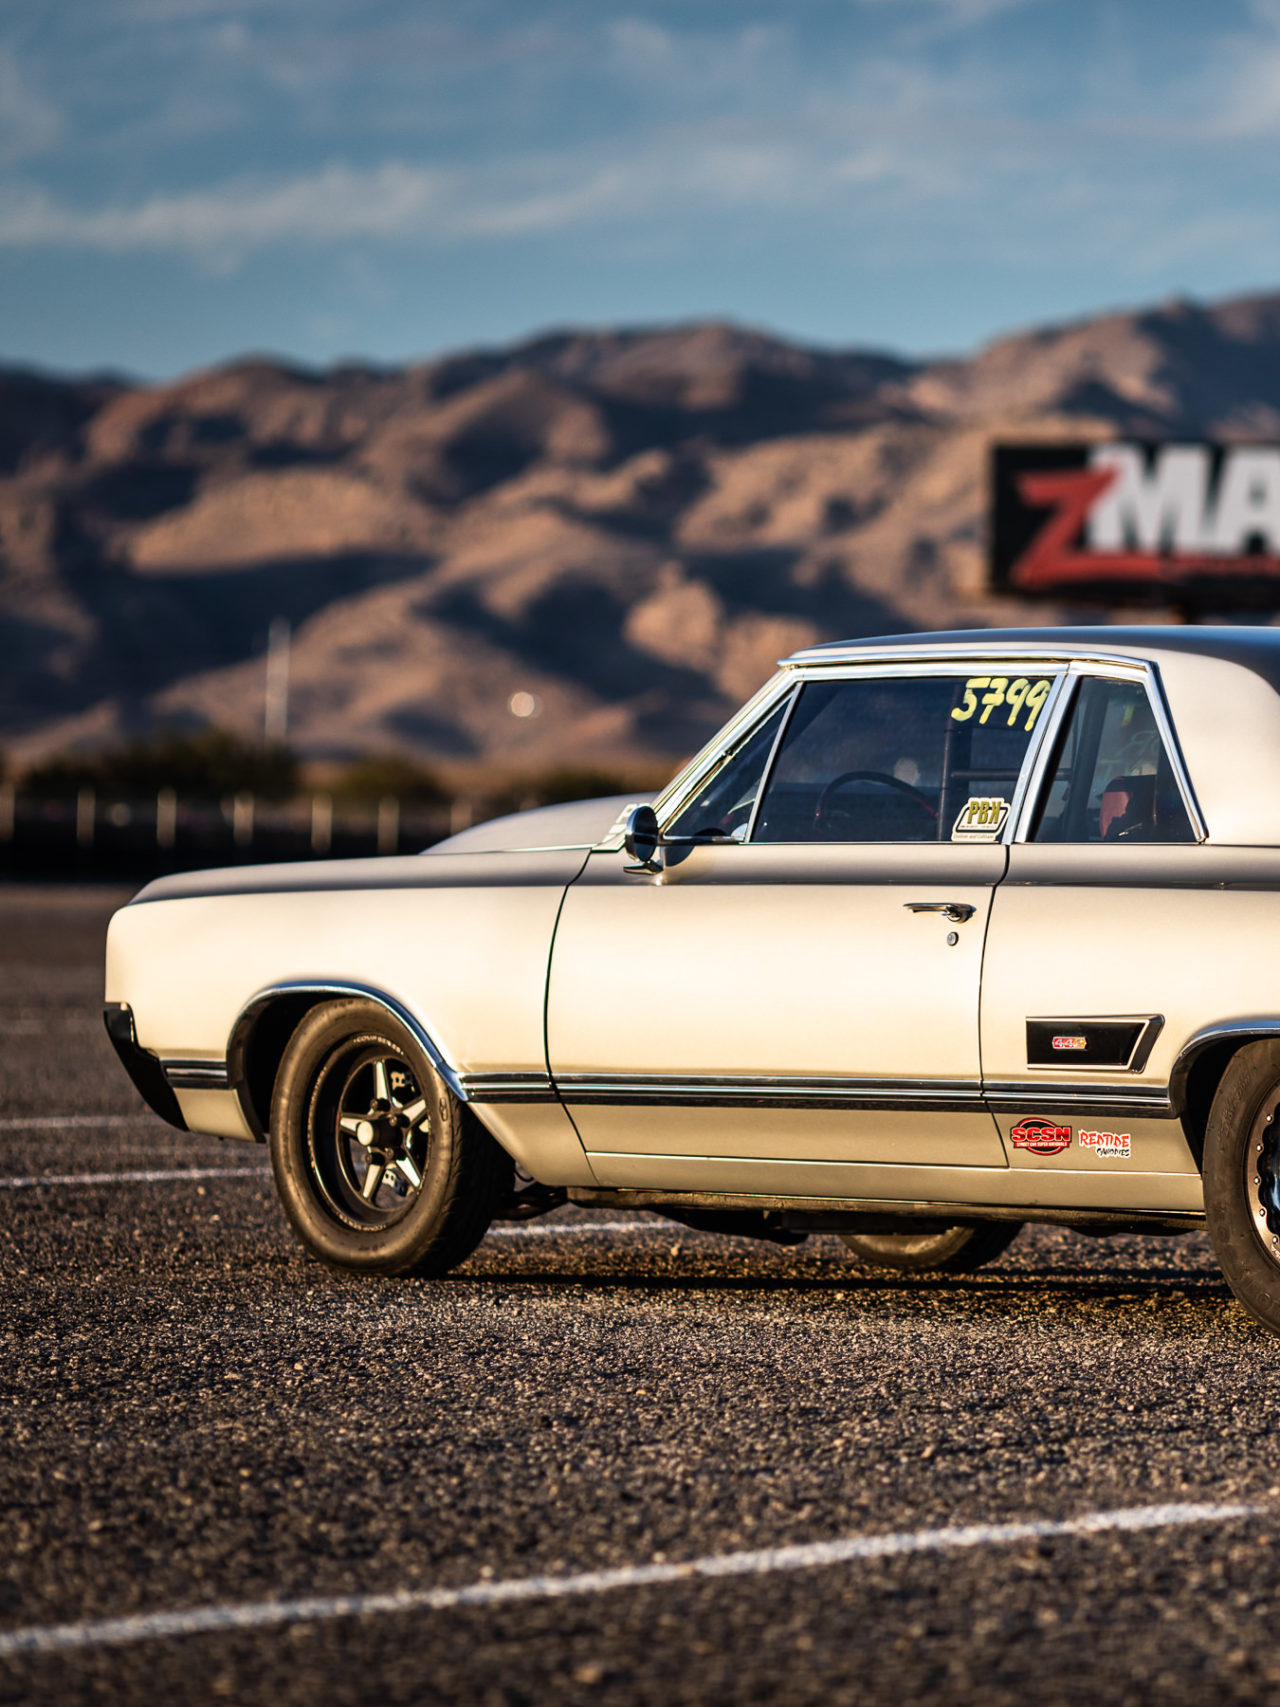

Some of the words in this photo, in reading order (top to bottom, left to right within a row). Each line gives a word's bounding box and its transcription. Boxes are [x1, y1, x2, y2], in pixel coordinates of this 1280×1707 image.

[951, 677, 1051, 731] 5799
[1011, 1127, 1071, 1142] SCSN
[1080, 1131, 1129, 1148] REDTIDE
